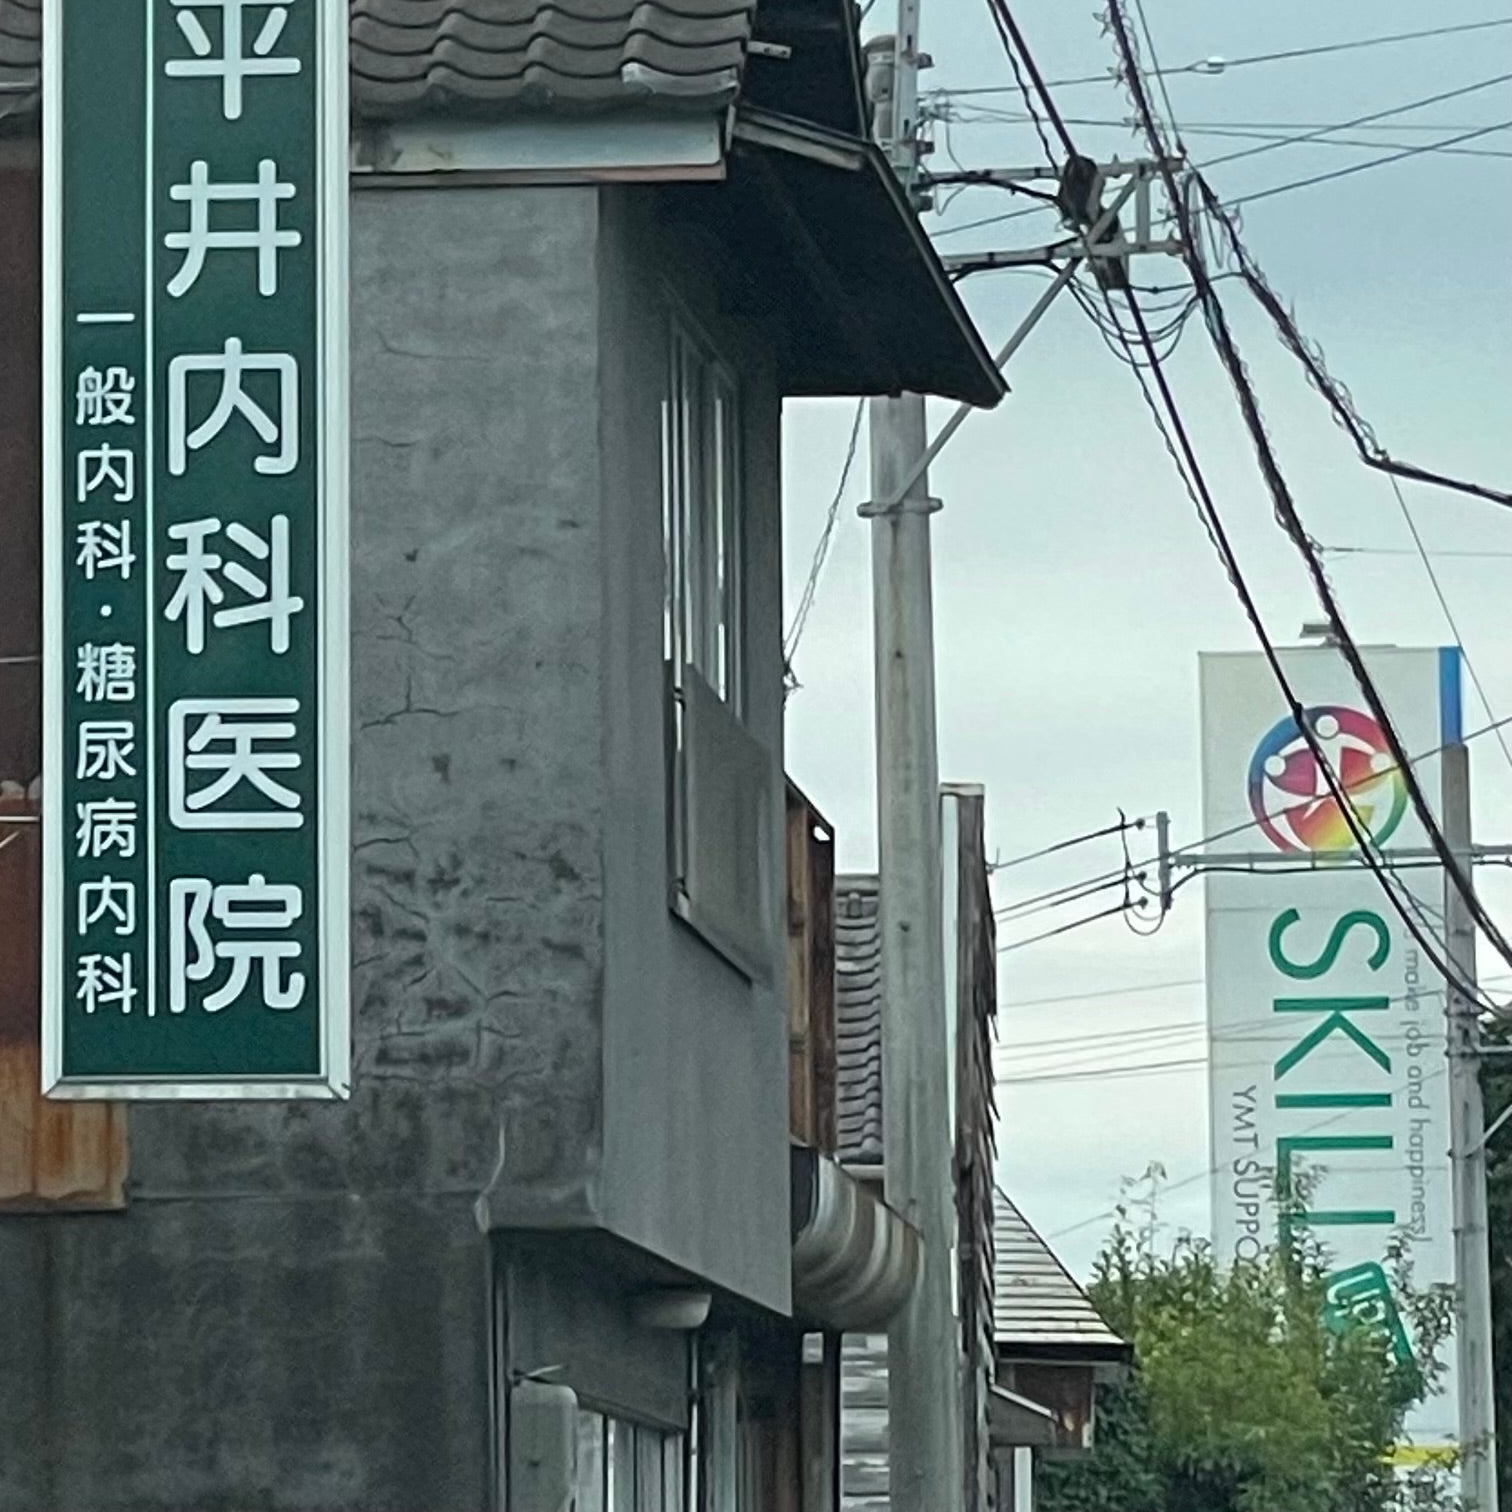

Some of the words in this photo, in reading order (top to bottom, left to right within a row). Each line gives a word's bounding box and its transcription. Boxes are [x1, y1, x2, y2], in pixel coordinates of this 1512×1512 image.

[1404, 949, 1428, 1011] make
[1400, 1020, 1430, 1057] job
[1268, 907, 1396, 1250] SKILL
[1407, 1065, 1430, 1109] and
[1232, 1084, 1259, 1150] YMT
